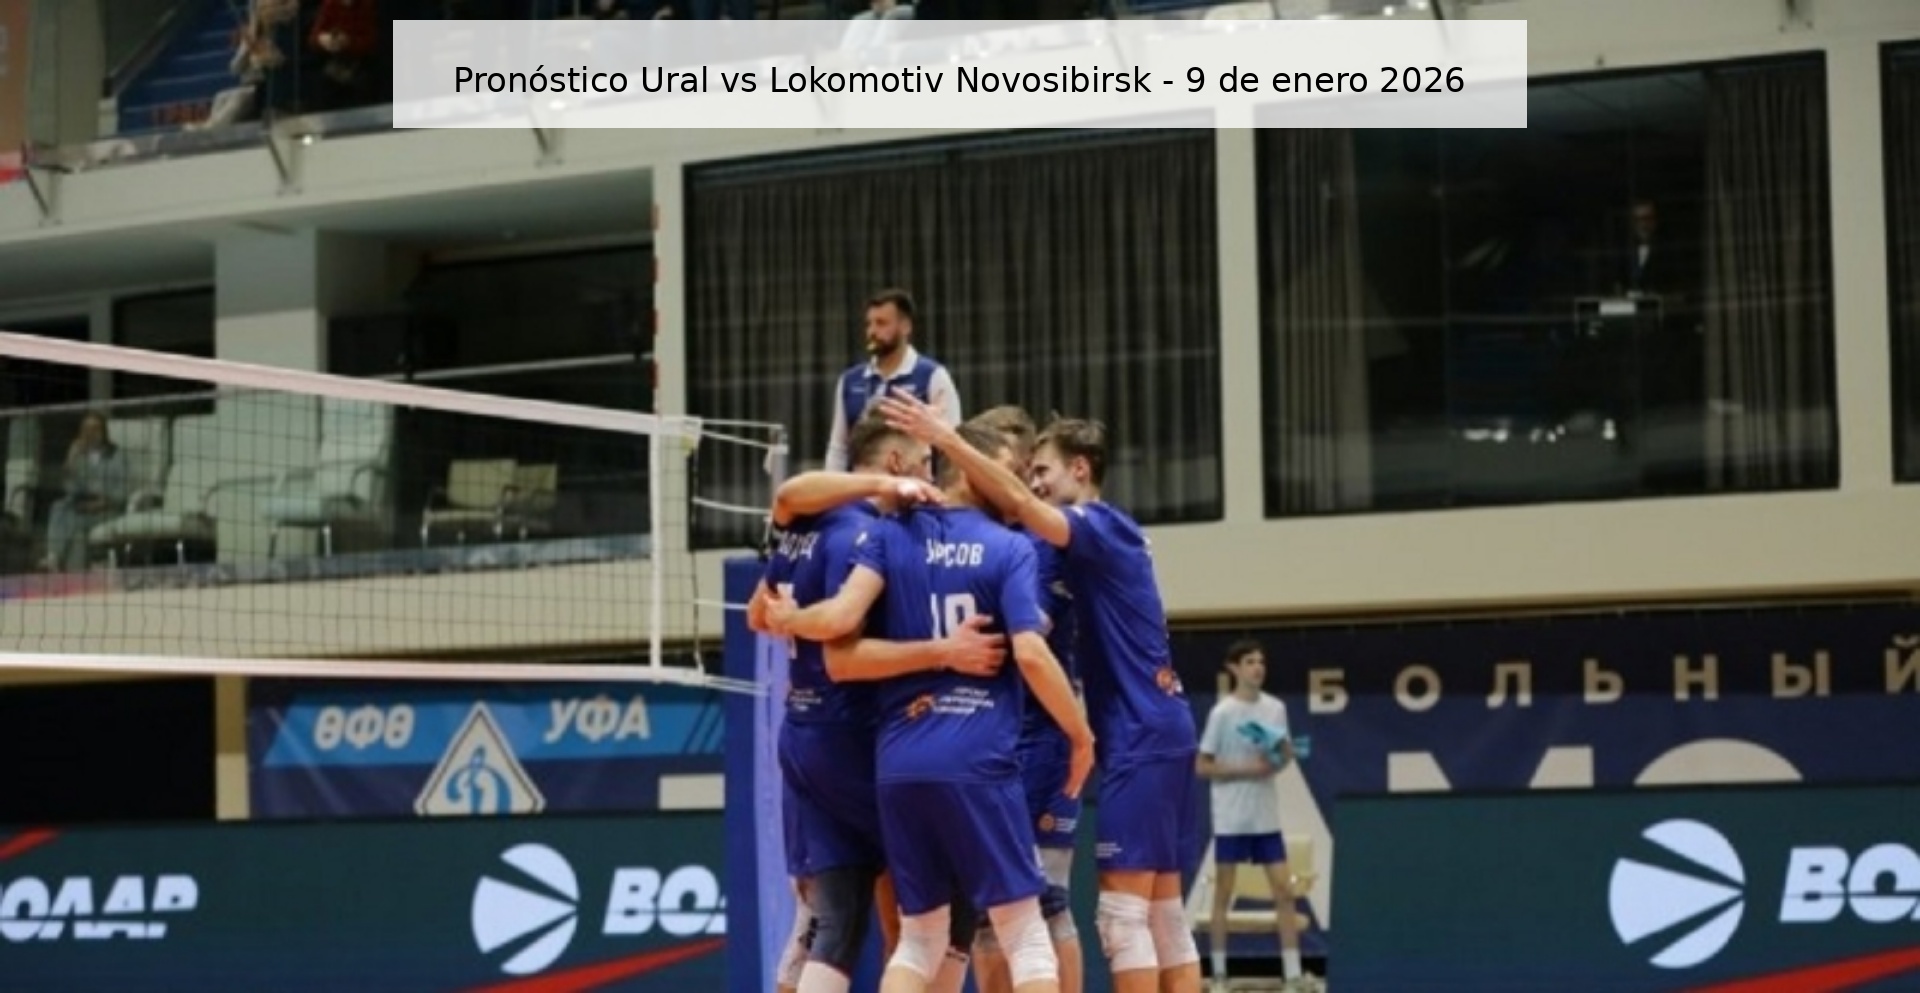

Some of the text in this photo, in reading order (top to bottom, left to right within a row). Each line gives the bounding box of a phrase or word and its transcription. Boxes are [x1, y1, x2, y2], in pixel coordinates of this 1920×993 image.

[1216, 634, 1920, 714] БОЛЬНЫЙ
[543, 695, 650, 743] УФА
[0, 873, 198, 942] ОЛАР
[1778, 843, 1920, 924] ВО
